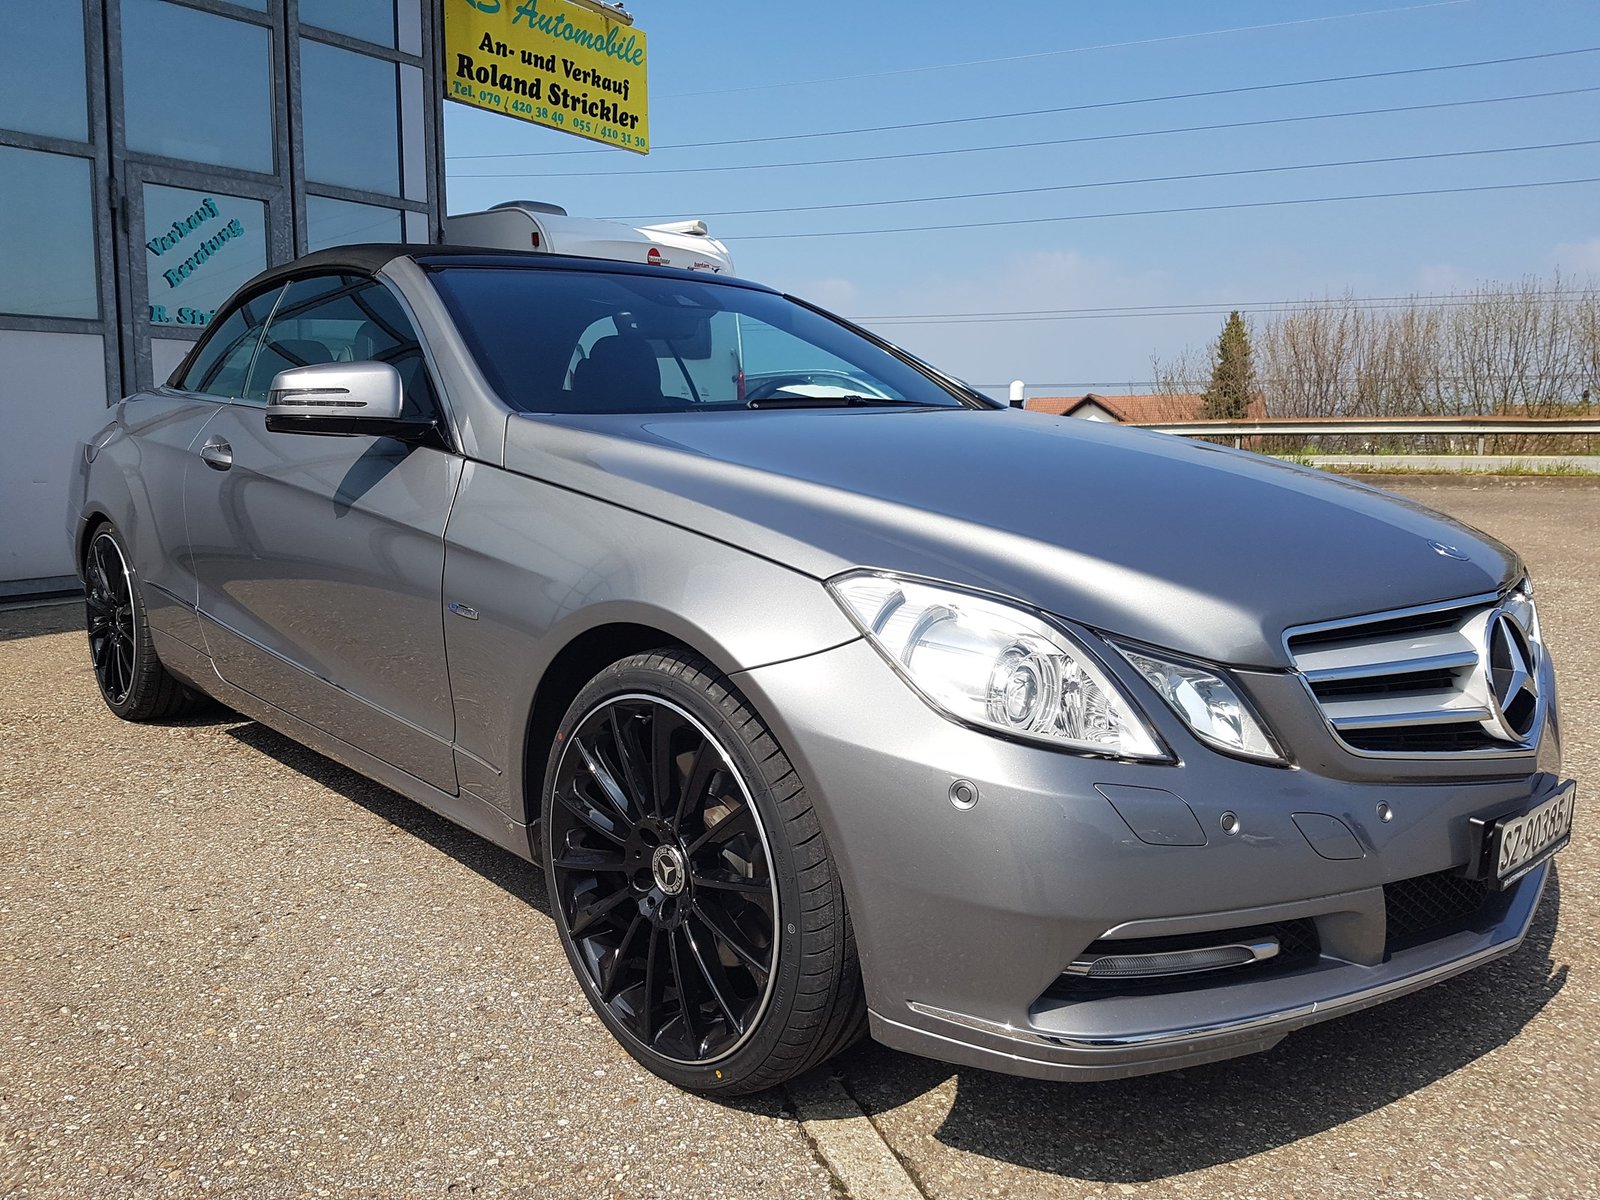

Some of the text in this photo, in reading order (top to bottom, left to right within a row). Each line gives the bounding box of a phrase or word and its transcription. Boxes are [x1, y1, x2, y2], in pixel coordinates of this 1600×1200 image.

[456, 53, 639, 130] Roland Strickler
[478, 32, 629, 101] An- und Verkauf
[453, 81, 476, 98] Tel.
[480, 90, 501, 106] 079
[512, 100, 532, 114] 420
[535, 106, 548, 118] 38
[551, 111, 564, 125] 49
[573, 118, 591, 132] 055
[601, 126, 618, 139] 410
[621, 132, 632, 143] 31
[635, 136, 646, 147] 30
[145, 197, 220, 257] Verkauf
[162, 218, 245, 289] Beratung
[148, 304, 174, 323] R.
